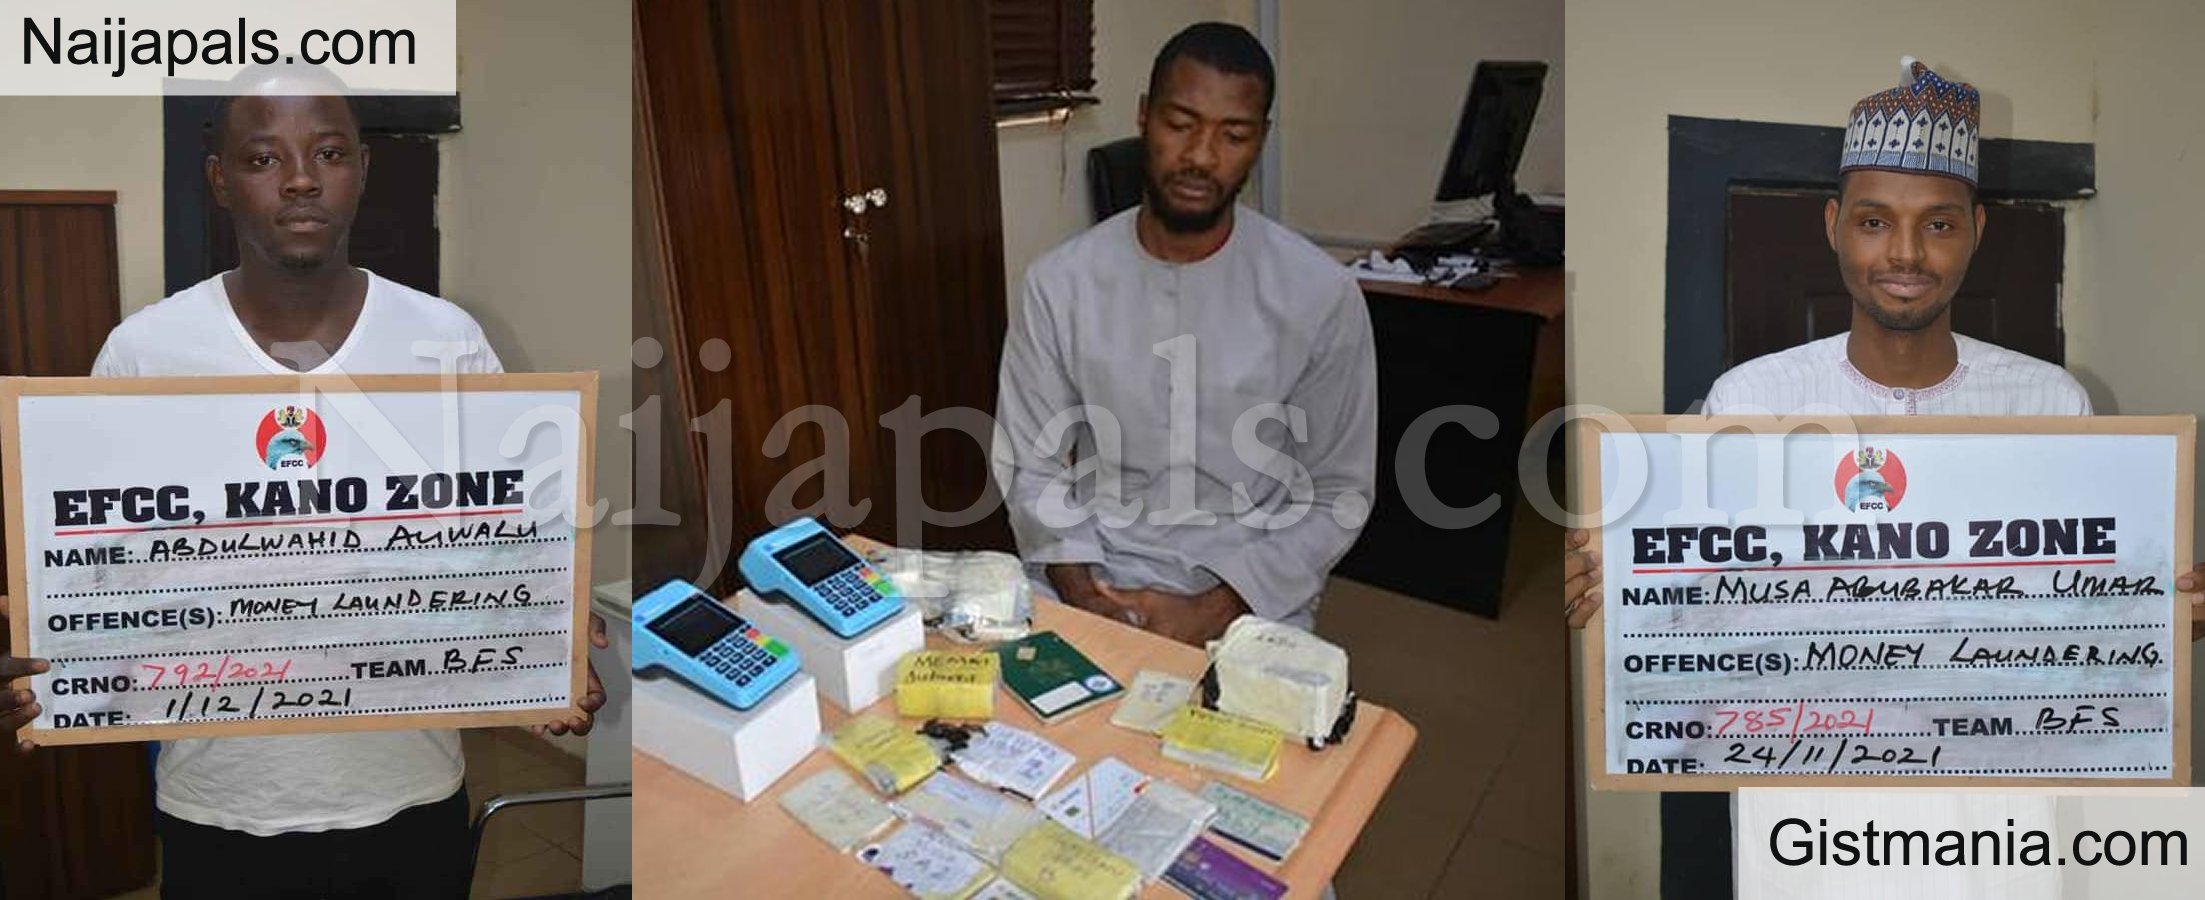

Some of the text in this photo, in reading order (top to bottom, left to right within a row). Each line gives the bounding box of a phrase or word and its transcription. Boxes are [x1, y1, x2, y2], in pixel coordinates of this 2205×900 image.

[280, 459, 305, 468] EFCC
[53, 469, 525, 526] EFCC, KANO ZONE
[1859, 501, 1884, 510] EFCC
[149, 531, 361, 562] ABDULWAHID
[1632, 517, 2117, 565] EFCC, KANO ZONE
[44, 547, 135, 568] NAME:
[230, 584, 533, 618] MONEY LAUNDERING
[1621, 587, 1710, 606] NAME:
[1713, 576, 1812, 605] MUSA
[2053, 569, 2166, 597] UMAR
[48, 605, 223, 634] OFFENCE(S):
[351, 659, 426, 680] TEAM
[1624, 653, 1799, 676] OFFENCE(S):
[1804, 641, 1925, 670] MONEY
[51, 674, 139, 696] CRNO:
[141, 654, 293, 692] 792/2021
[166, 687, 352, 722] 1/12/2021
[53, 710, 131, 729] DATE:
[1625, 721, 1713, 740] CRNO:
[1713, 702, 1874, 743] 785/2021
[1932, 718, 2013, 737] TEAM
[1723, 738, 1943, 770] 24/11/2021
